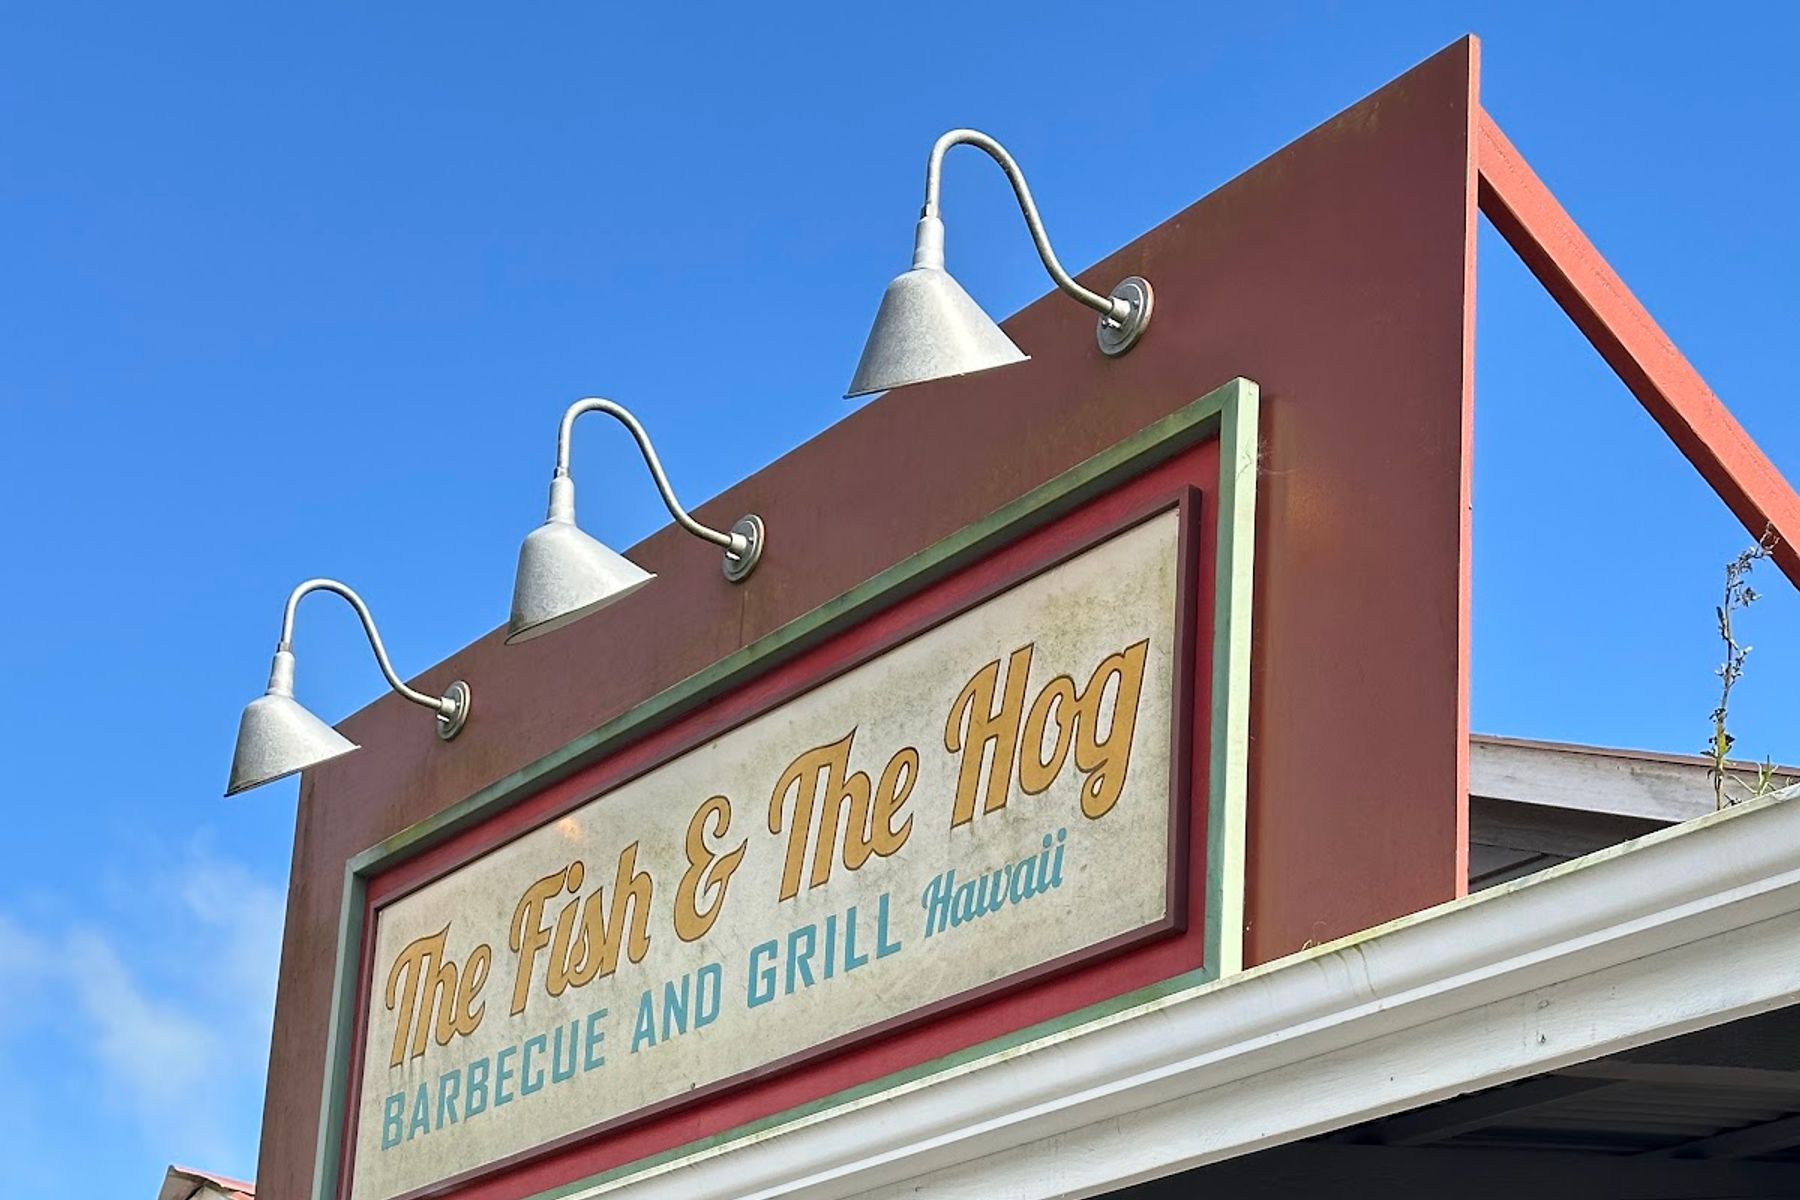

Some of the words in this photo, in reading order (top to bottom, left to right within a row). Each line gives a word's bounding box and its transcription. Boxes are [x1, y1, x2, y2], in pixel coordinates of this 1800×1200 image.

[381, 1007, 609, 1151] BARBECUE
[630, 962, 722, 1055] AND
[747, 893, 902, 1008] GRILL
[921, 828, 1068, 937] Hawaii
[386, 921, 492, 1068] The
[510, 841, 653, 1016] Fish
[674, 795, 748, 943] &
[768, 725, 919, 902] The
[944, 638, 1150, 830] Hog
